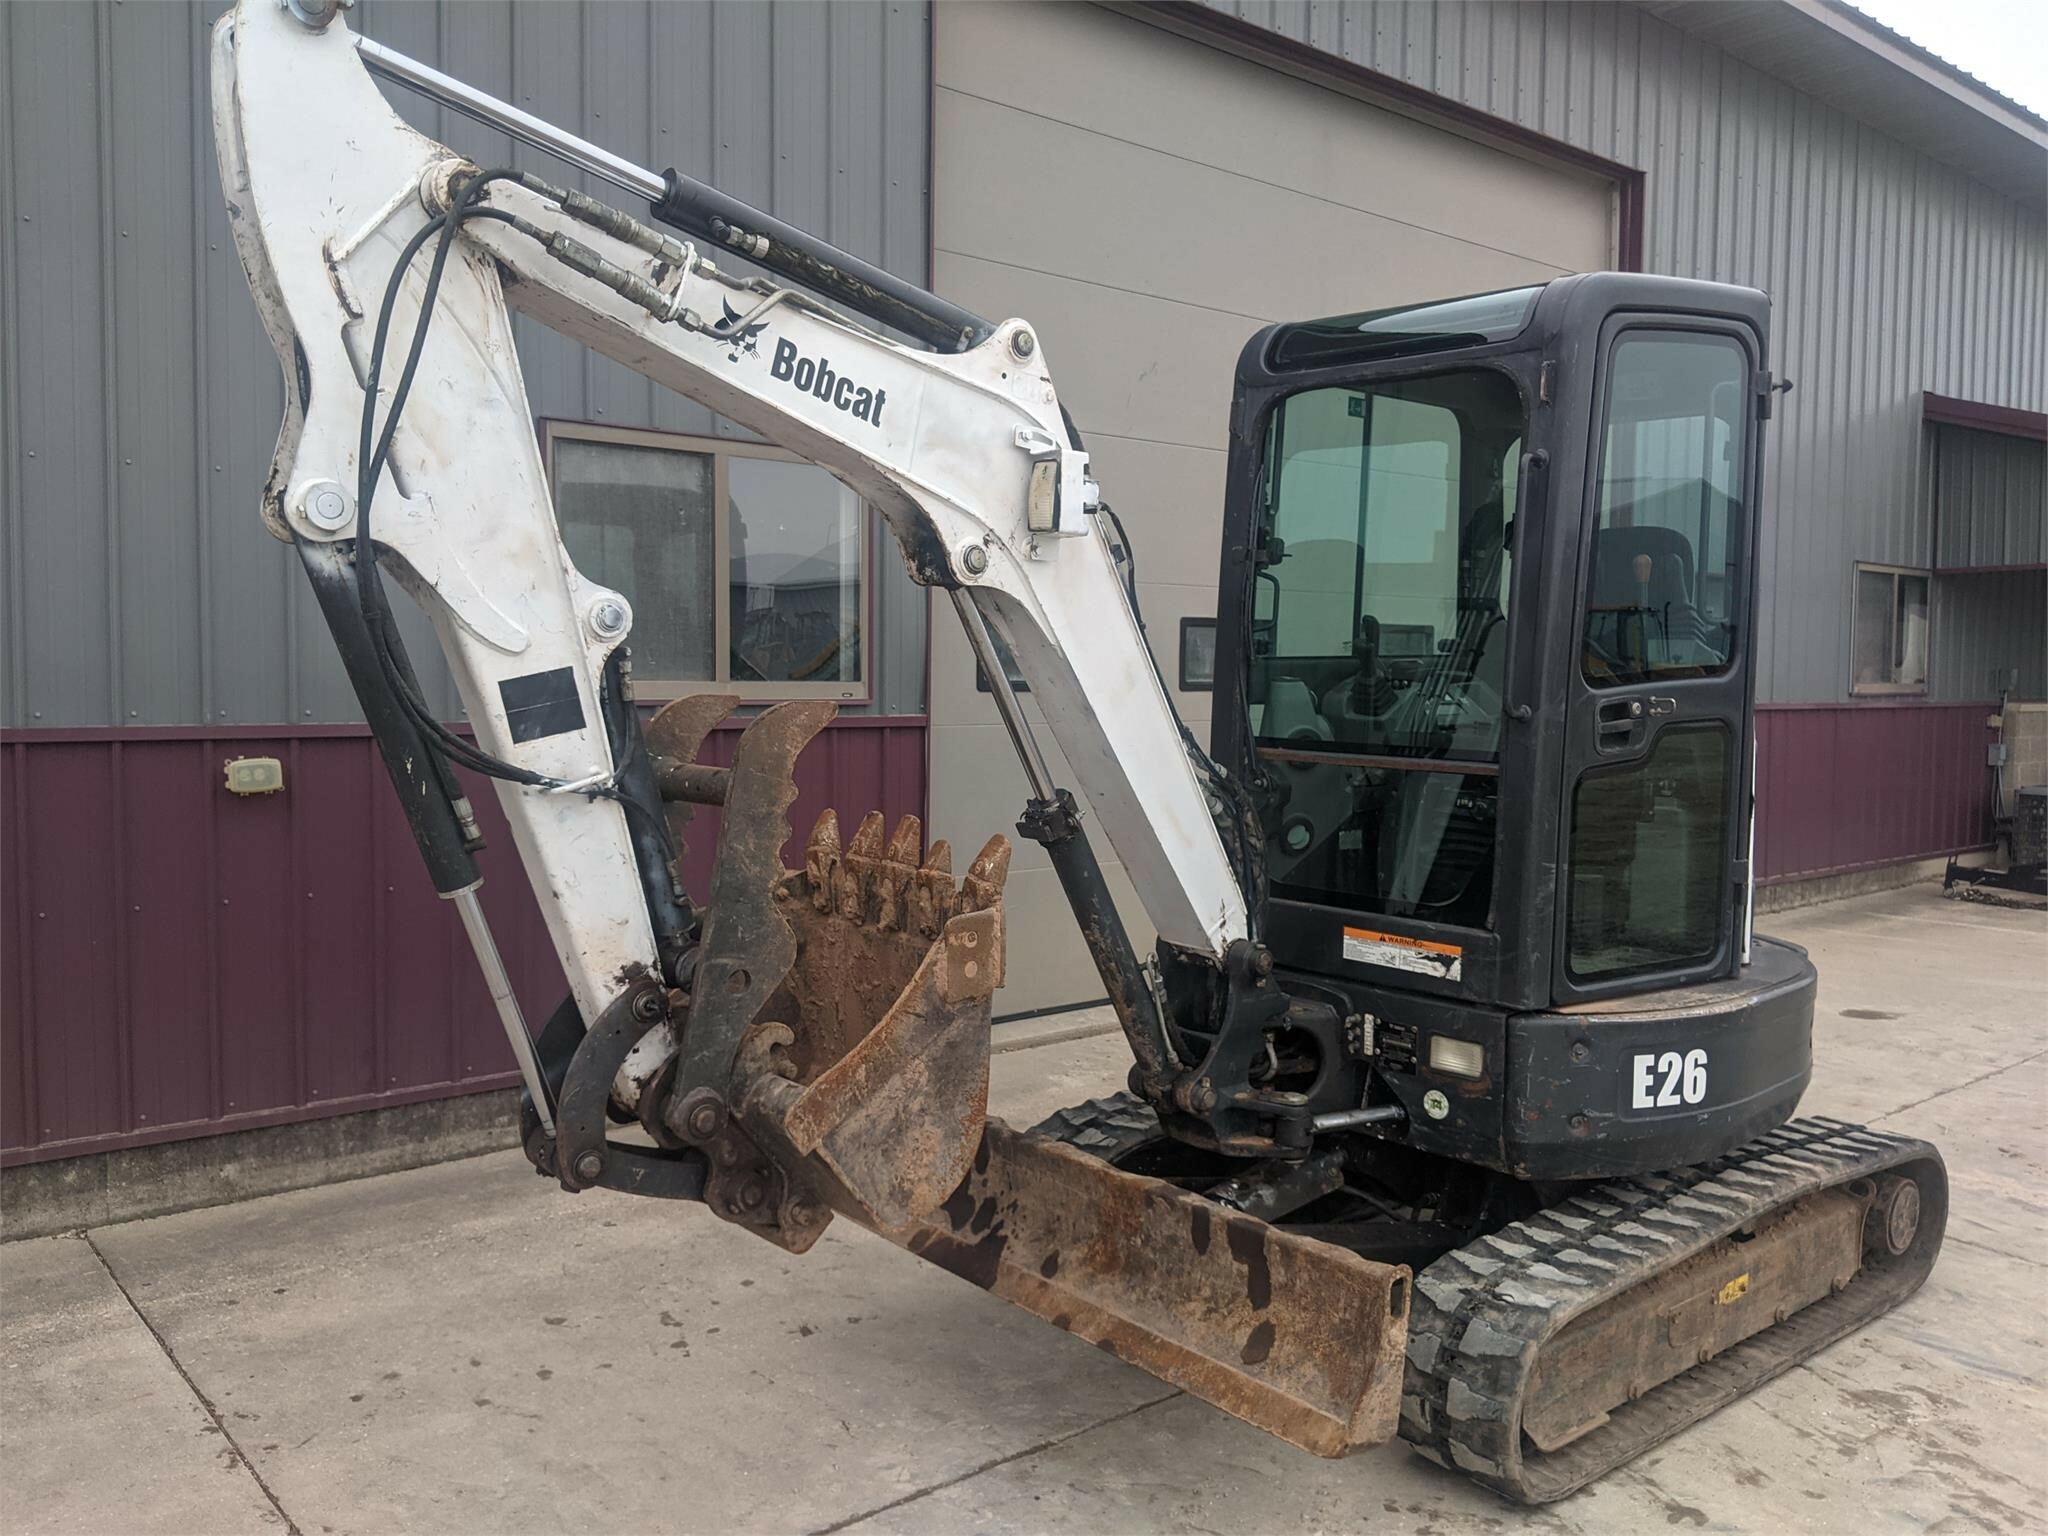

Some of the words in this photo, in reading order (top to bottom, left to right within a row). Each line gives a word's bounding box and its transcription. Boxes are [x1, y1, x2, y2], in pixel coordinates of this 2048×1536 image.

[770, 336, 886, 428] Bobcat
[1387, 935, 1423, 949] WARNING
[1632, 1048, 1708, 1110] E26
